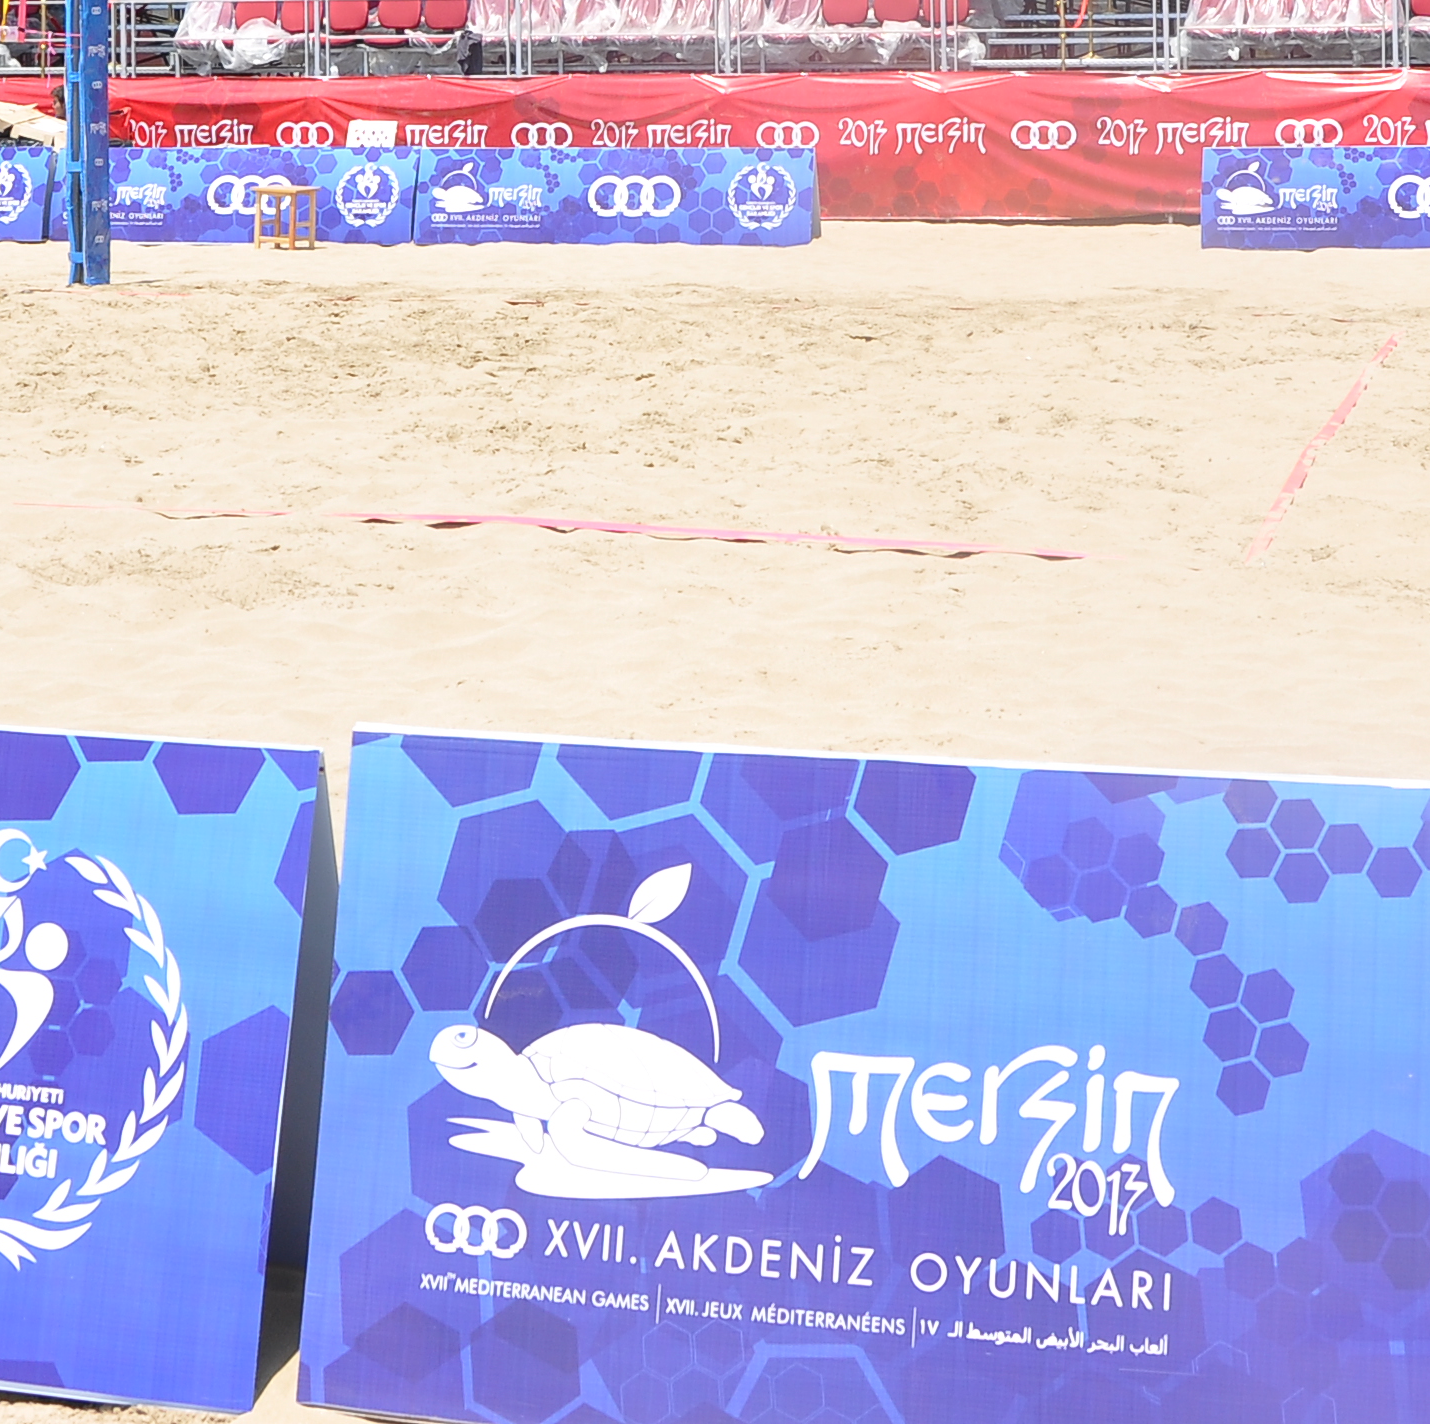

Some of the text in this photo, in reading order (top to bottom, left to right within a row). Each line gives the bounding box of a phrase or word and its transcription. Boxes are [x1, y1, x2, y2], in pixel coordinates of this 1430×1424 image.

[591, 118, 639, 147] 2013
[838, 117, 888, 155] 2013
[1096, 116, 1148, 155] 2013
[1362, 114, 1416, 145] 2013
[27, 1106, 106, 1145] SPOR
[1046, 1153, 1148, 1236] 2013
[545, 1219, 1171, 1311] XVII. AKDENİZ OYUNLARI
[454, 1277, 586, 1306] MEDITERRANEAN
[591, 1290, 650, 1312] GAMES
[665, 1297, 906, 1335] XVII. JEUX MÉDITERRANÉENS
